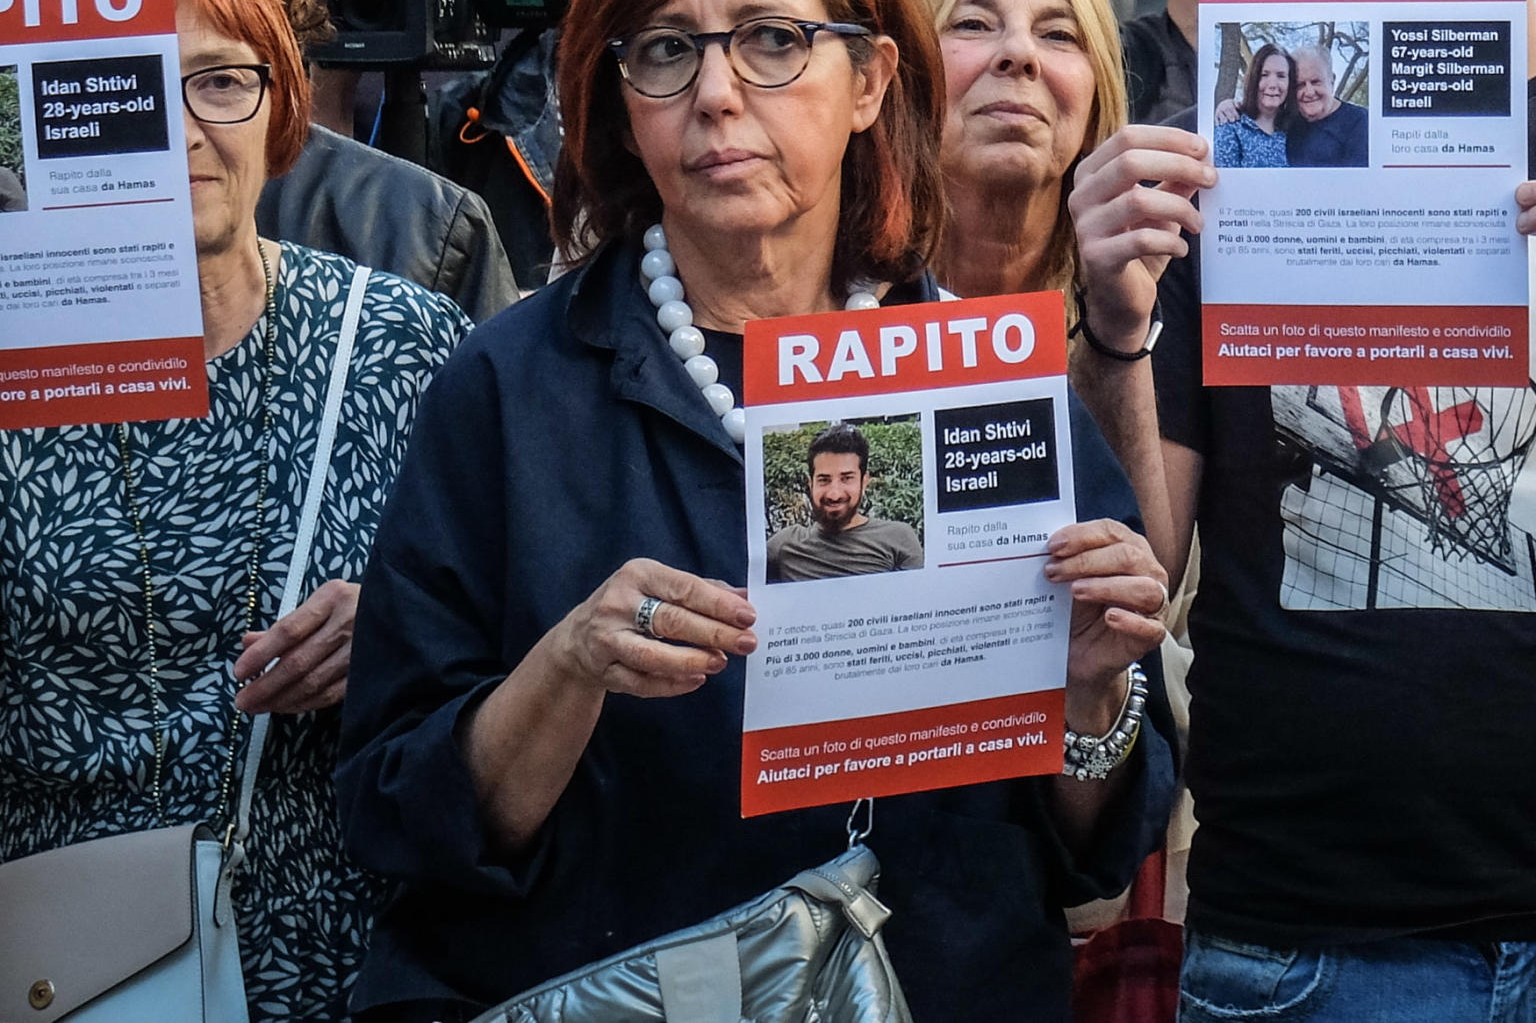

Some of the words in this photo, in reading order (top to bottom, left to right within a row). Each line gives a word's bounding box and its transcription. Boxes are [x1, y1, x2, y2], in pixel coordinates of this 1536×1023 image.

[1391, 29, 1428, 41] Yossi
[1431, 29, 1498, 41] Silberman
[1391, 45, 1473, 60] 67-years-old
[1391, 62, 1434, 77] Margit
[1436, 62, 1504, 74] Silberman
[41, 79, 81, 95] Idan
[85, 74, 137, 92] Shtivi
[1391, 78, 1473, 94] 63-years-old
[43, 95, 154, 120] 28-years-old
[1391, 95, 1432, 108] Israeli
[45, 121, 100, 140] Israeli
[100, 182, 115, 191] da
[117, 180, 155, 190] Hamas
[778, 312, 1035, 386] RAPITO
[1217, 343, 1271, 357] Aiutaci
[1275, 346, 1301, 359] per
[1304, 343, 1352, 357] favore
[1356, 347, 1366, 358] a
[1369, 344, 1425, 361] portarli
[1428, 347, 1438, 358] a
[1442, 347, 1478, 358] casa
[1481, 345, 1513, 359] vivi.
[30, 389, 40, 400] a
[44, 382, 100, 401] portarli
[104, 383, 114, 394] a
[118, 381, 155, 393] casa
[158, 376, 191, 391] vivi.
[944, 427, 980, 445] Idan
[984, 419, 1031, 440] Shtivi
[944, 441, 1046, 470] 28-years-old
[945, 471, 998, 492] Israeli
[996, 535, 1009, 545] da
[1012, 533, 1050, 545] Hamas
[760, 746, 800, 762] Scatta
[803, 744, 819, 756] un
[823, 741, 847, 753] foto
[849, 737, 862, 750] di
[864, 732, 907, 750] questo
[909, 723, 968, 742] manifesto
[970, 722, 979, 732] e
[981, 711, 1047, 731] condividilo
[756, 763, 810, 784] Aiutaci
[814, 763, 841, 779] per
[843, 755, 891, 772] favore
[894, 754, 904, 765] a
[908, 741, 962, 766] portarli
[965, 743, 974, 754] a
[978, 737, 1013, 752] casa
[1016, 730, 1047, 746] vivi.
